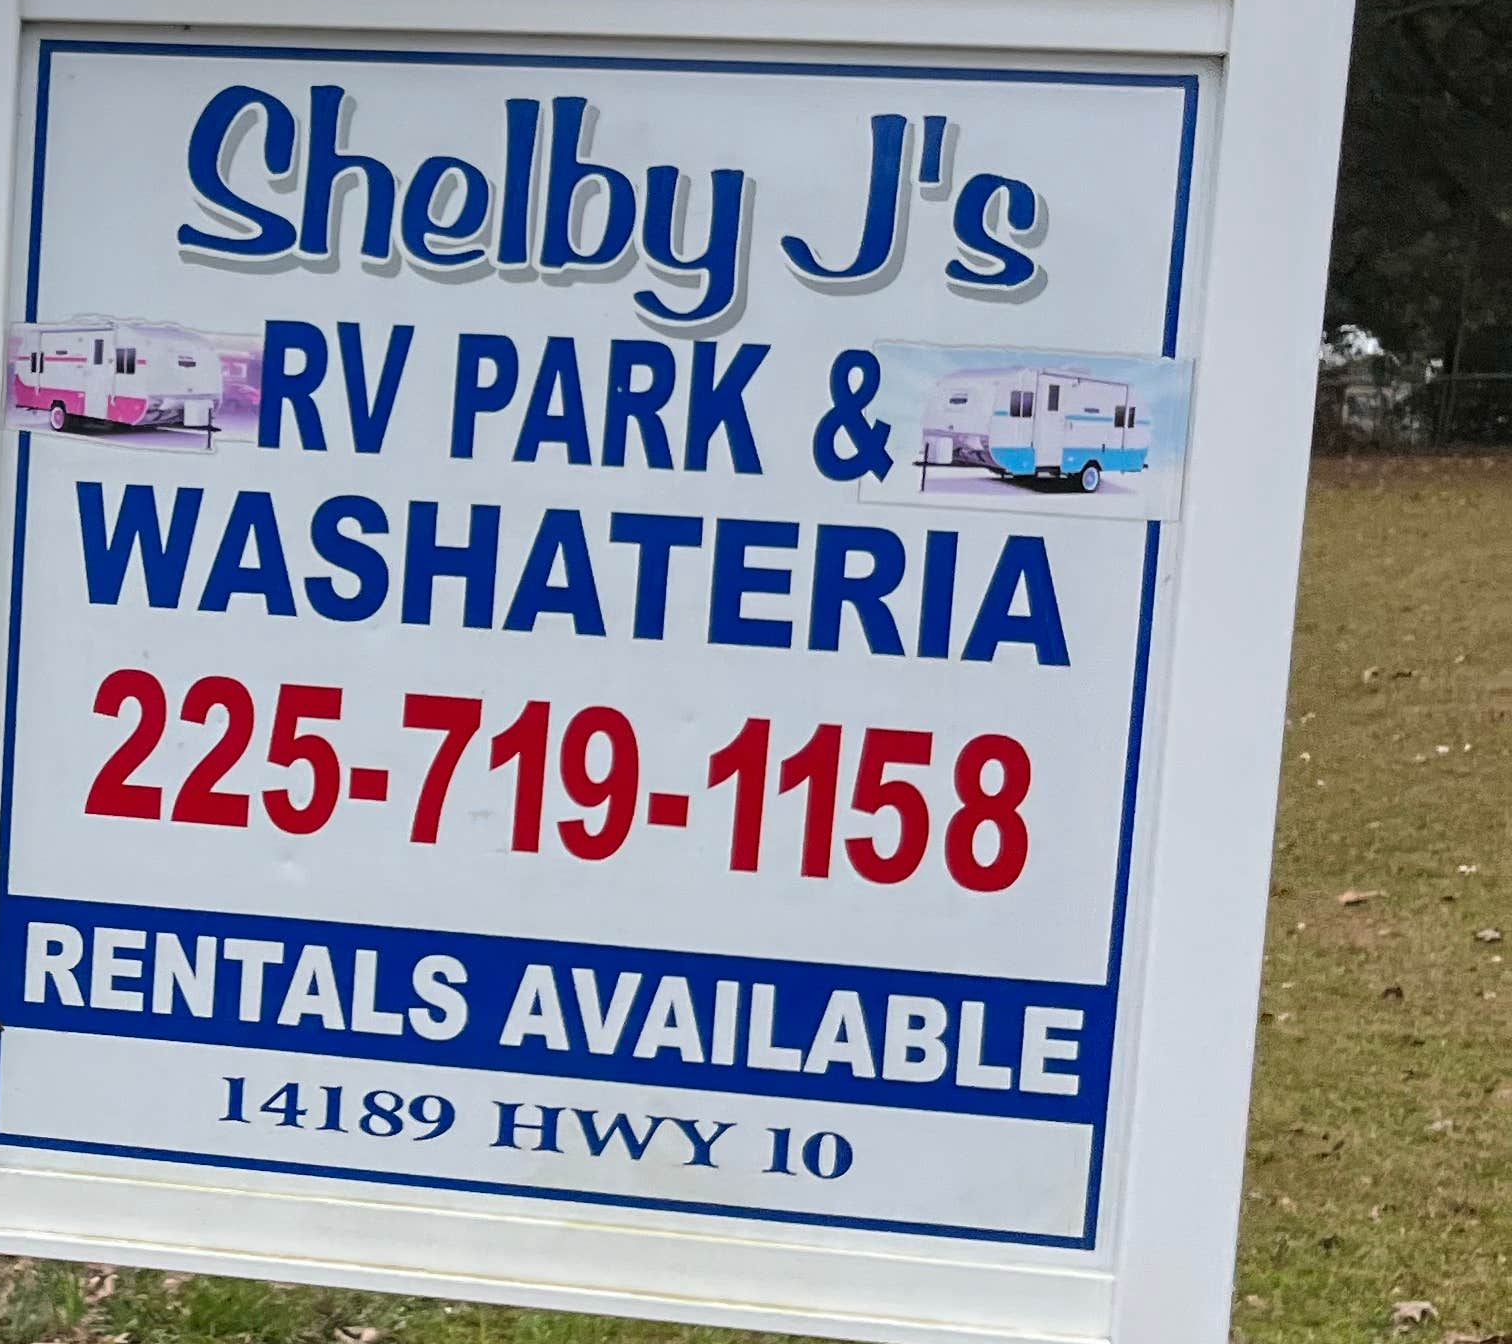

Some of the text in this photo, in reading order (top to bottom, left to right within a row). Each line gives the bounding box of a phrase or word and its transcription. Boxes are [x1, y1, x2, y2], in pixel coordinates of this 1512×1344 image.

[179, 84, 1040, 324] Shelby J's
[257, 319, 895, 482] RV PARK &
[75, 480, 1072, 667] WASHATERIA
[84, 668, 1032, 892] 225-719-1158
[23, 920, 1085, 1096] RENTALS AVAILABLE
[220, 1076, 854, 1180] 14189 HWY 10
